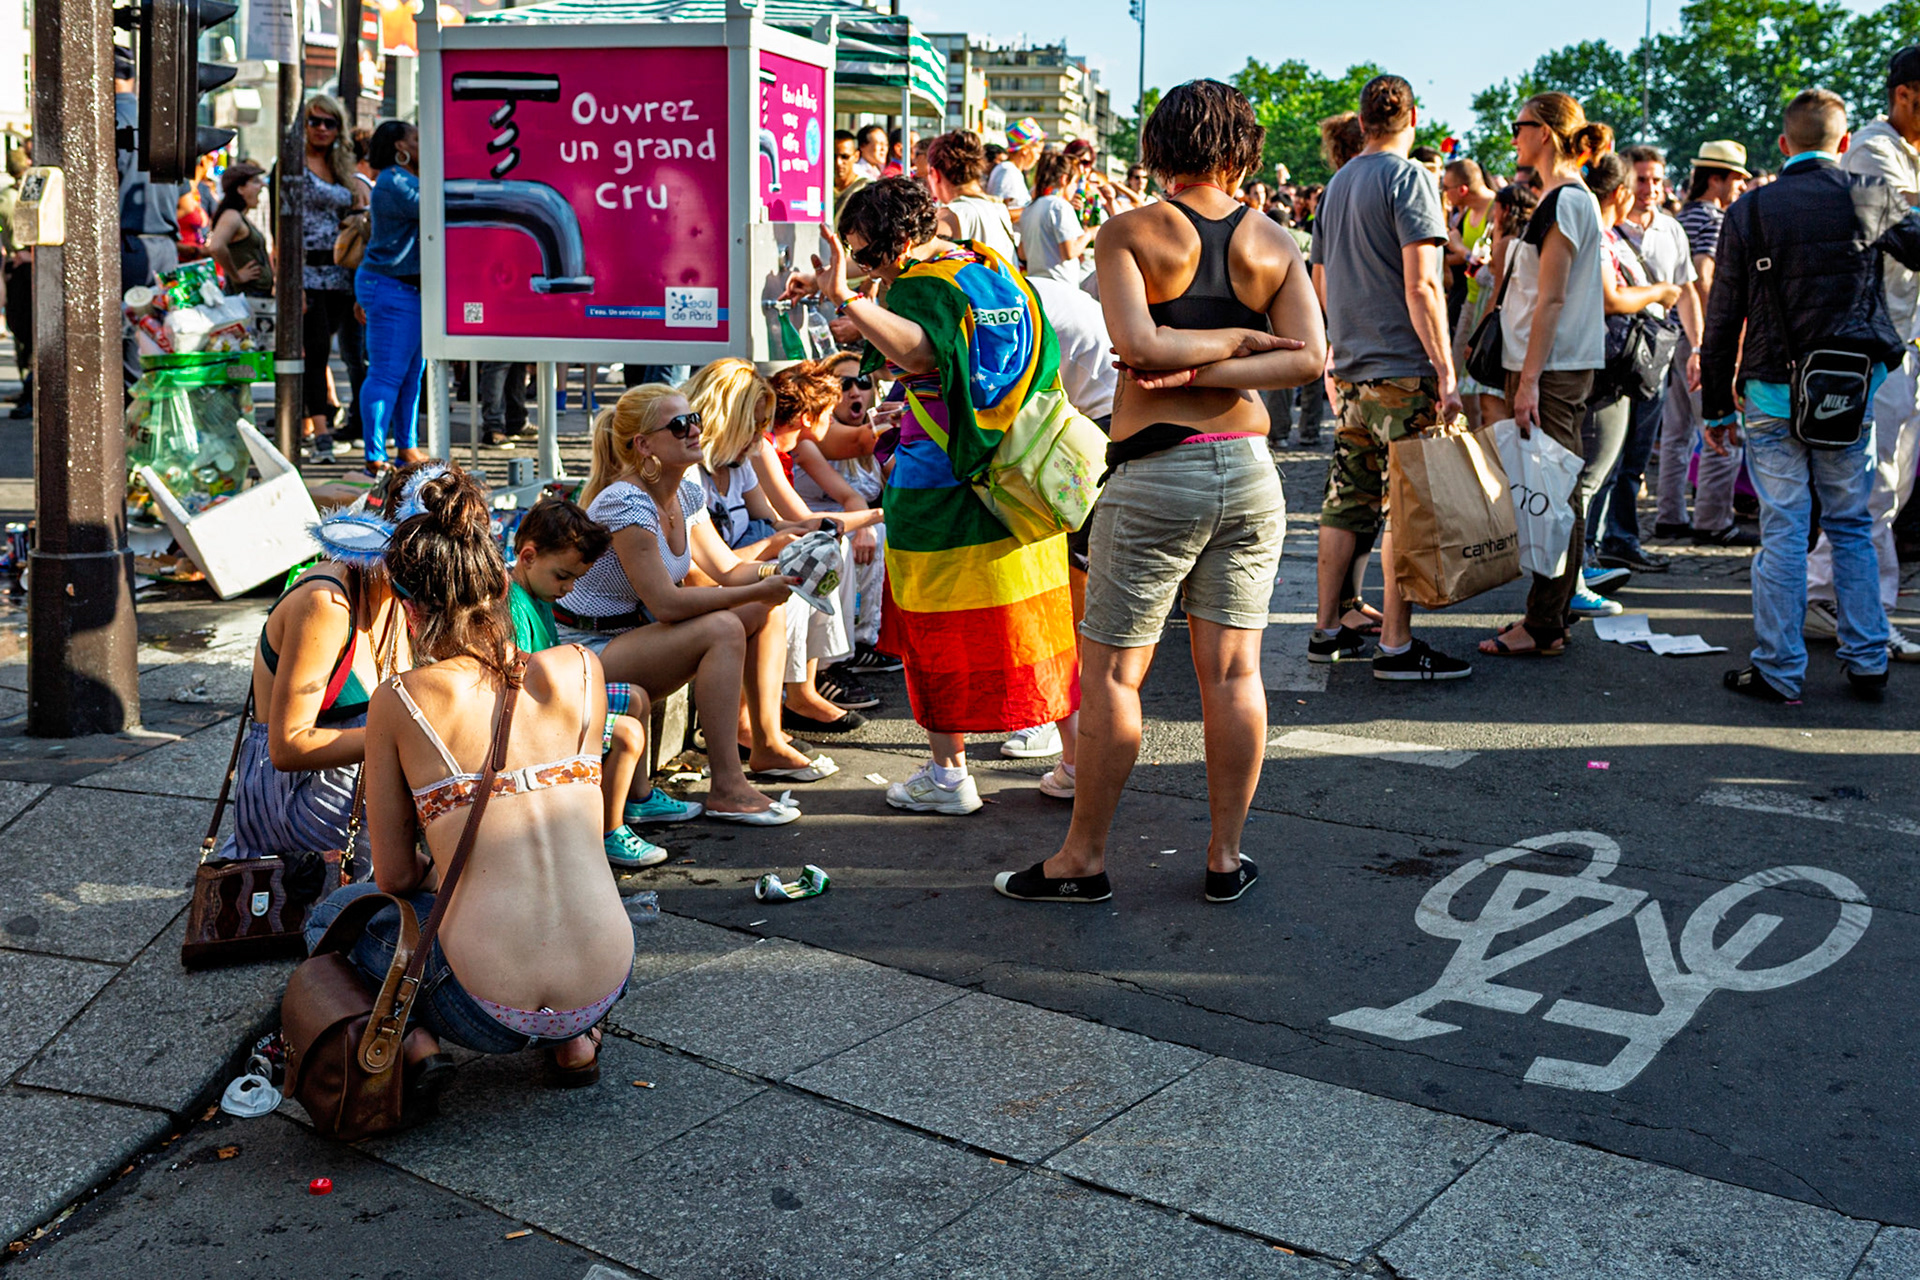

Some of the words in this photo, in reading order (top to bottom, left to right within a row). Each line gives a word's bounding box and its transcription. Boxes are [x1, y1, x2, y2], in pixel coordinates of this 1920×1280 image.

[571, 92, 699, 125] Ouvrez
[560, 140, 599, 163] un
[613, 128, 716, 175] grand
[595, 182, 668, 210] cru
[619, 309, 641, 317] service
[689, 310, 713, 321] Paris
[1822, 393, 1851, 410] NIKE
[1510, 483, 1550, 517] TO
